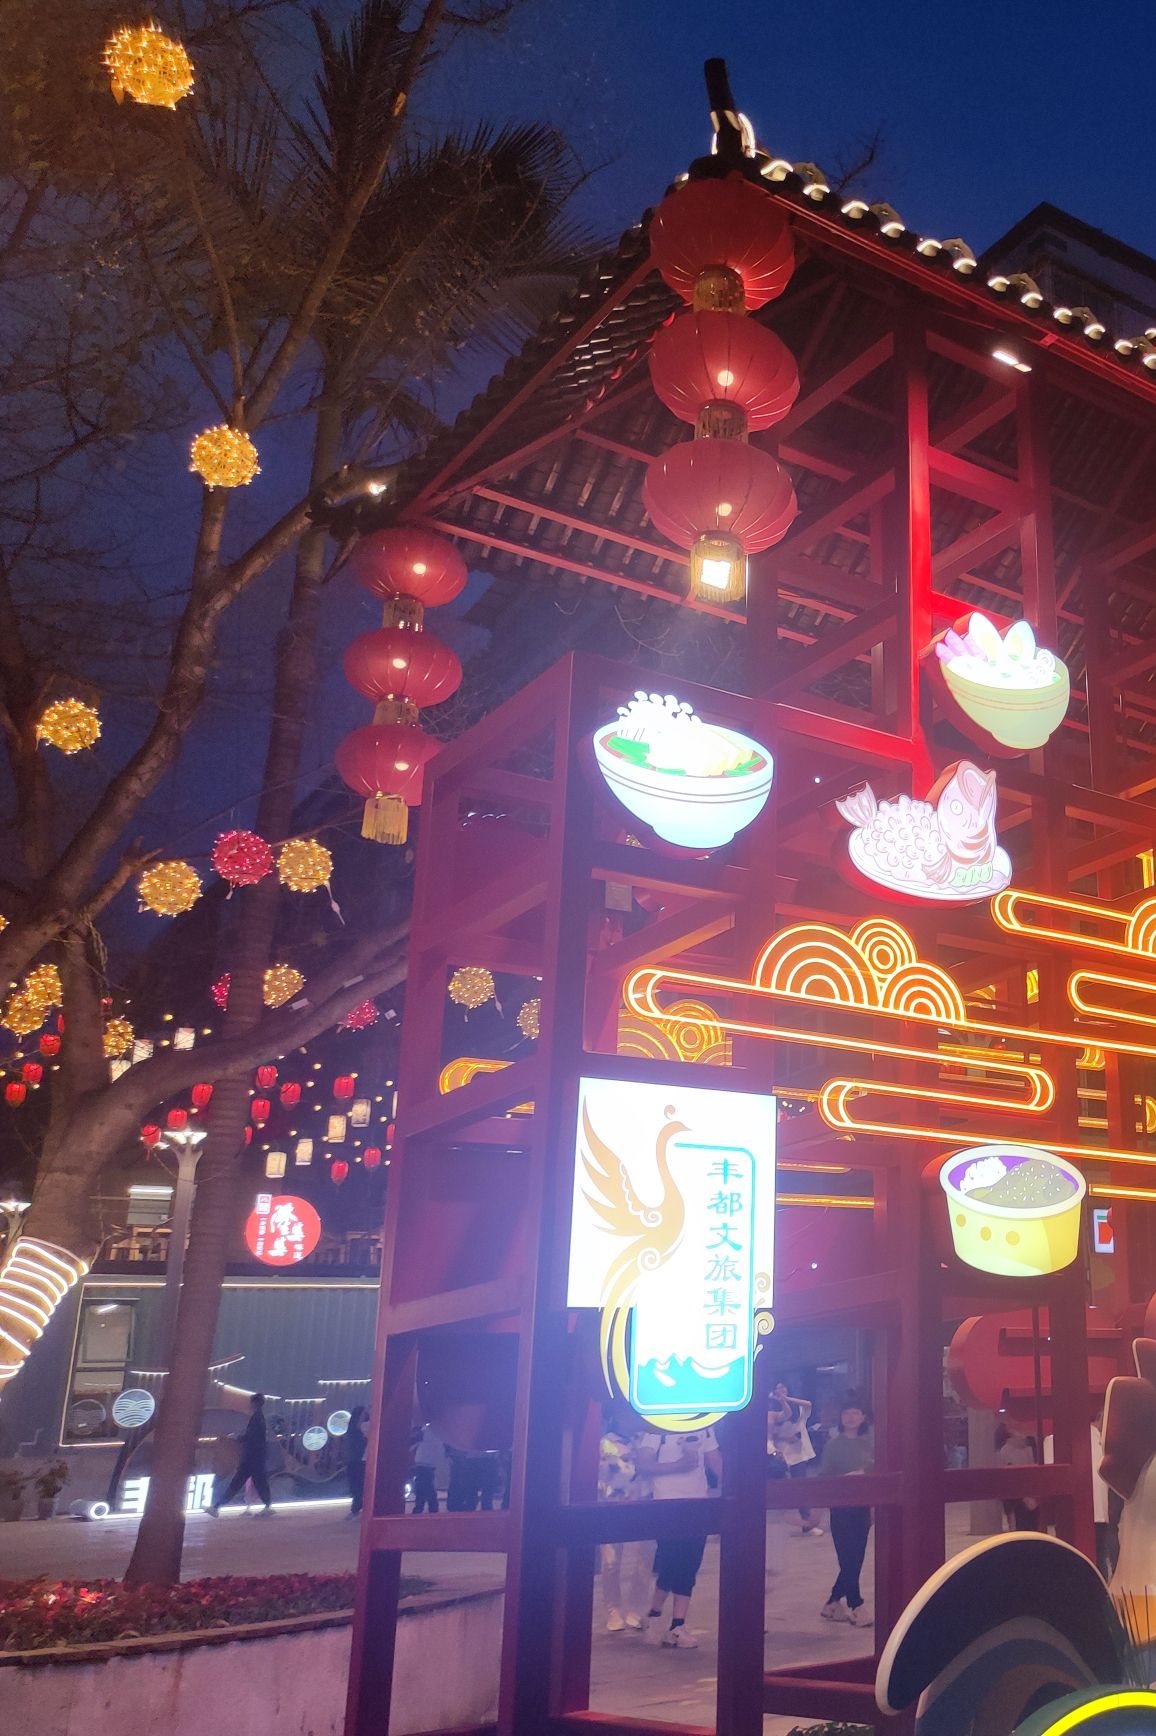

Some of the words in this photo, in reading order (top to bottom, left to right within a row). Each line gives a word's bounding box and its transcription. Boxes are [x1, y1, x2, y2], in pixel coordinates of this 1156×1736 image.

[704, 1157, 744, 1350] 丰都文旅集团
